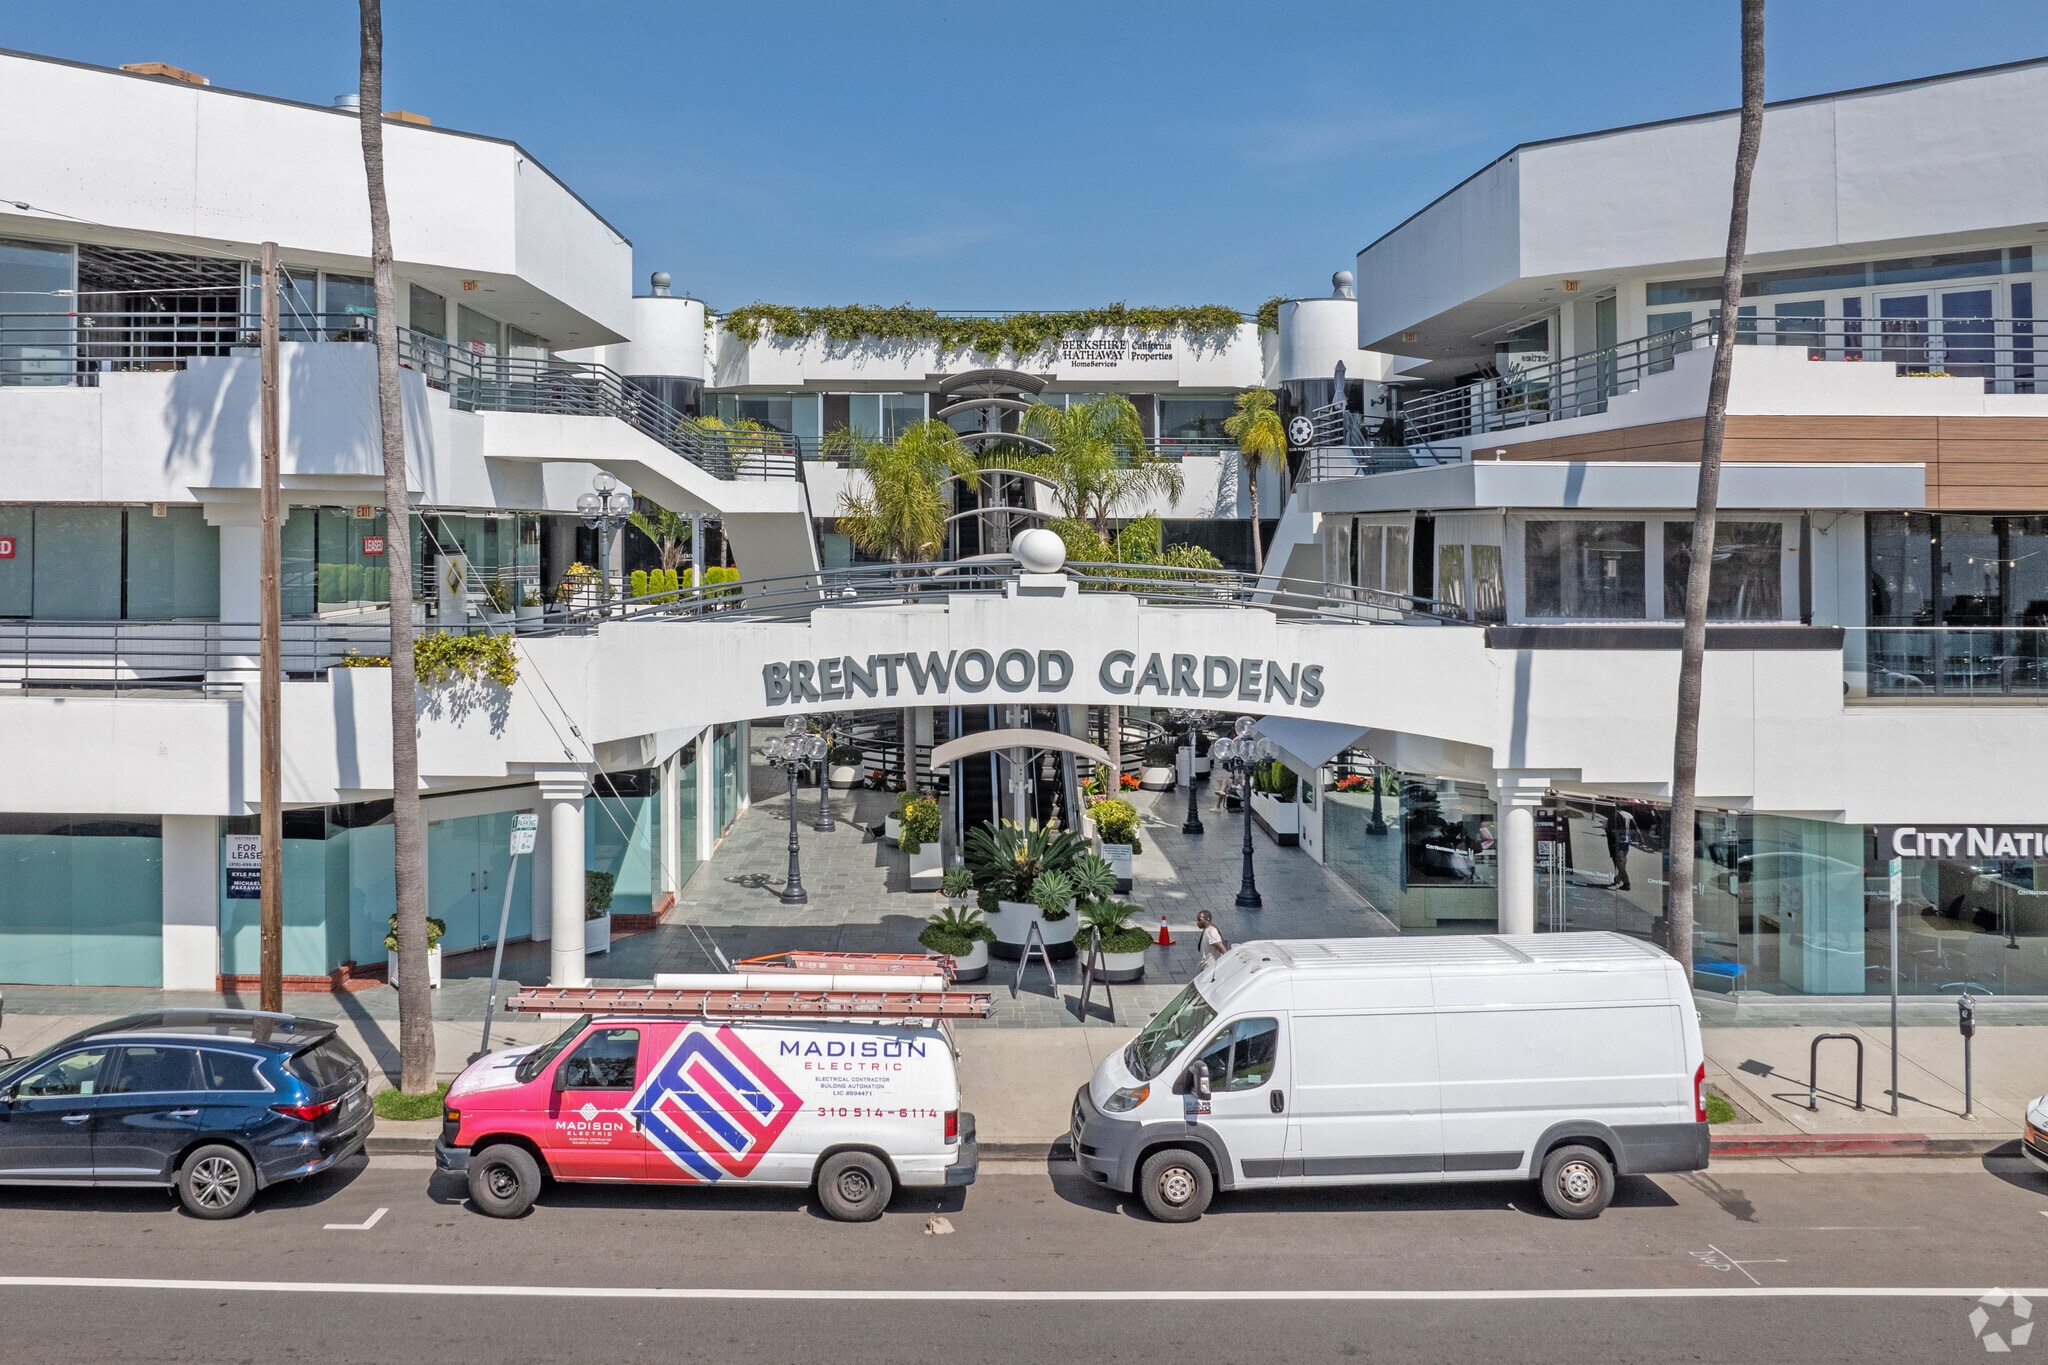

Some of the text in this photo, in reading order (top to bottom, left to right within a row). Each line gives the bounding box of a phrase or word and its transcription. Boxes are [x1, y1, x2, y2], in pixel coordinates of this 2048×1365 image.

[463, 281, 475, 291] EXIT
[1566, 281, 1578, 291] EXIT
[1405, 333, 1415, 341] EXIT
[1062, 340, 1126, 350] BERKSHIRE
[1131, 341, 1172, 350] California
[1063, 350, 1125, 360] HATHAWAY
[1131, 351, 1173, 362] Properties
[1071, 360, 1117, 368] HomeServices
[357, 506, 371, 517] EXIT
[365, 539, 384, 551] LEASED
[762, 648, 1326, 708] BRENTWOOD GARDENS
[232, 852, 262, 860] LEASE
[780, 1040, 926, 1058] MADISON
[804, 1062, 902, 1071] ELECTRIC
[817, 1107, 847, 1117] 310
[555, 1121, 623, 1131] MADISON
